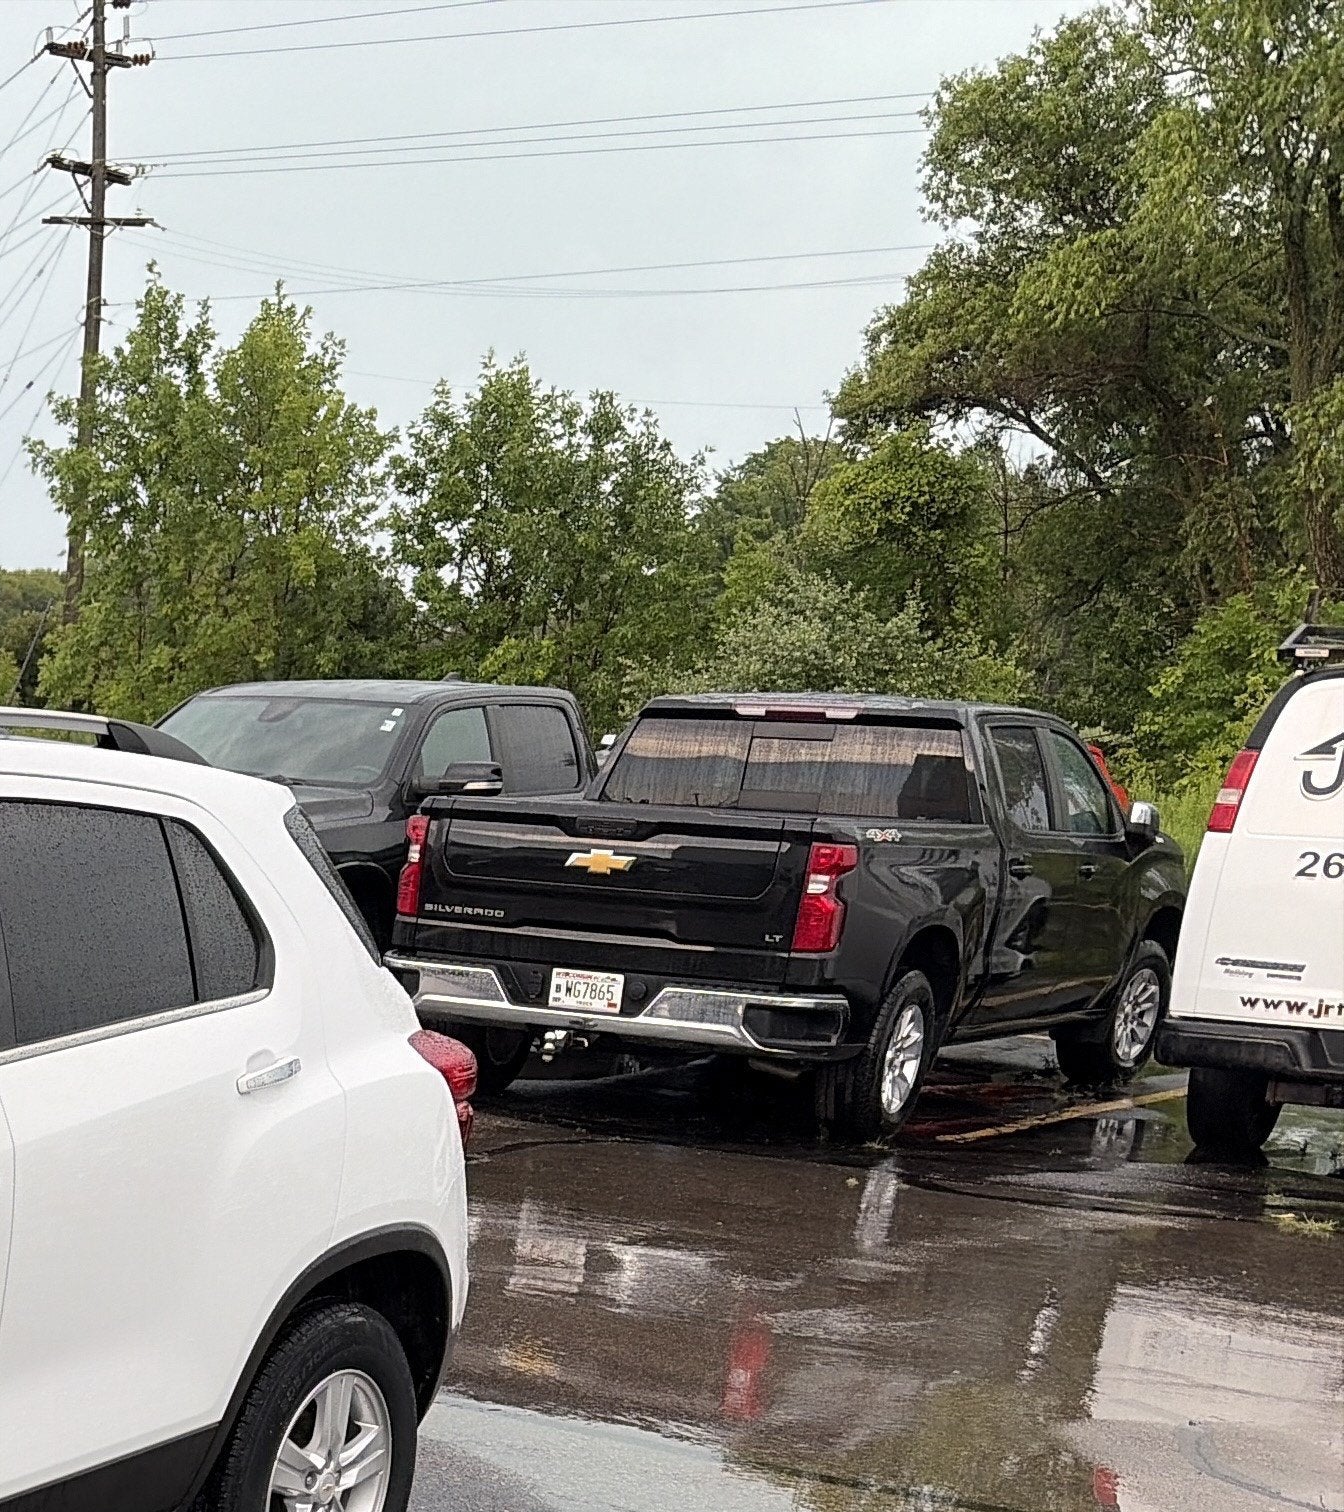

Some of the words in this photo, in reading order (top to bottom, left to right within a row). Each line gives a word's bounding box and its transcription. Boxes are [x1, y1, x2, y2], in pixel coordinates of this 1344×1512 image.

[424, 903, 506, 918] SILVERADO
[764, 933, 783, 943] LT
[565, 980, 615, 1001] WG7865
